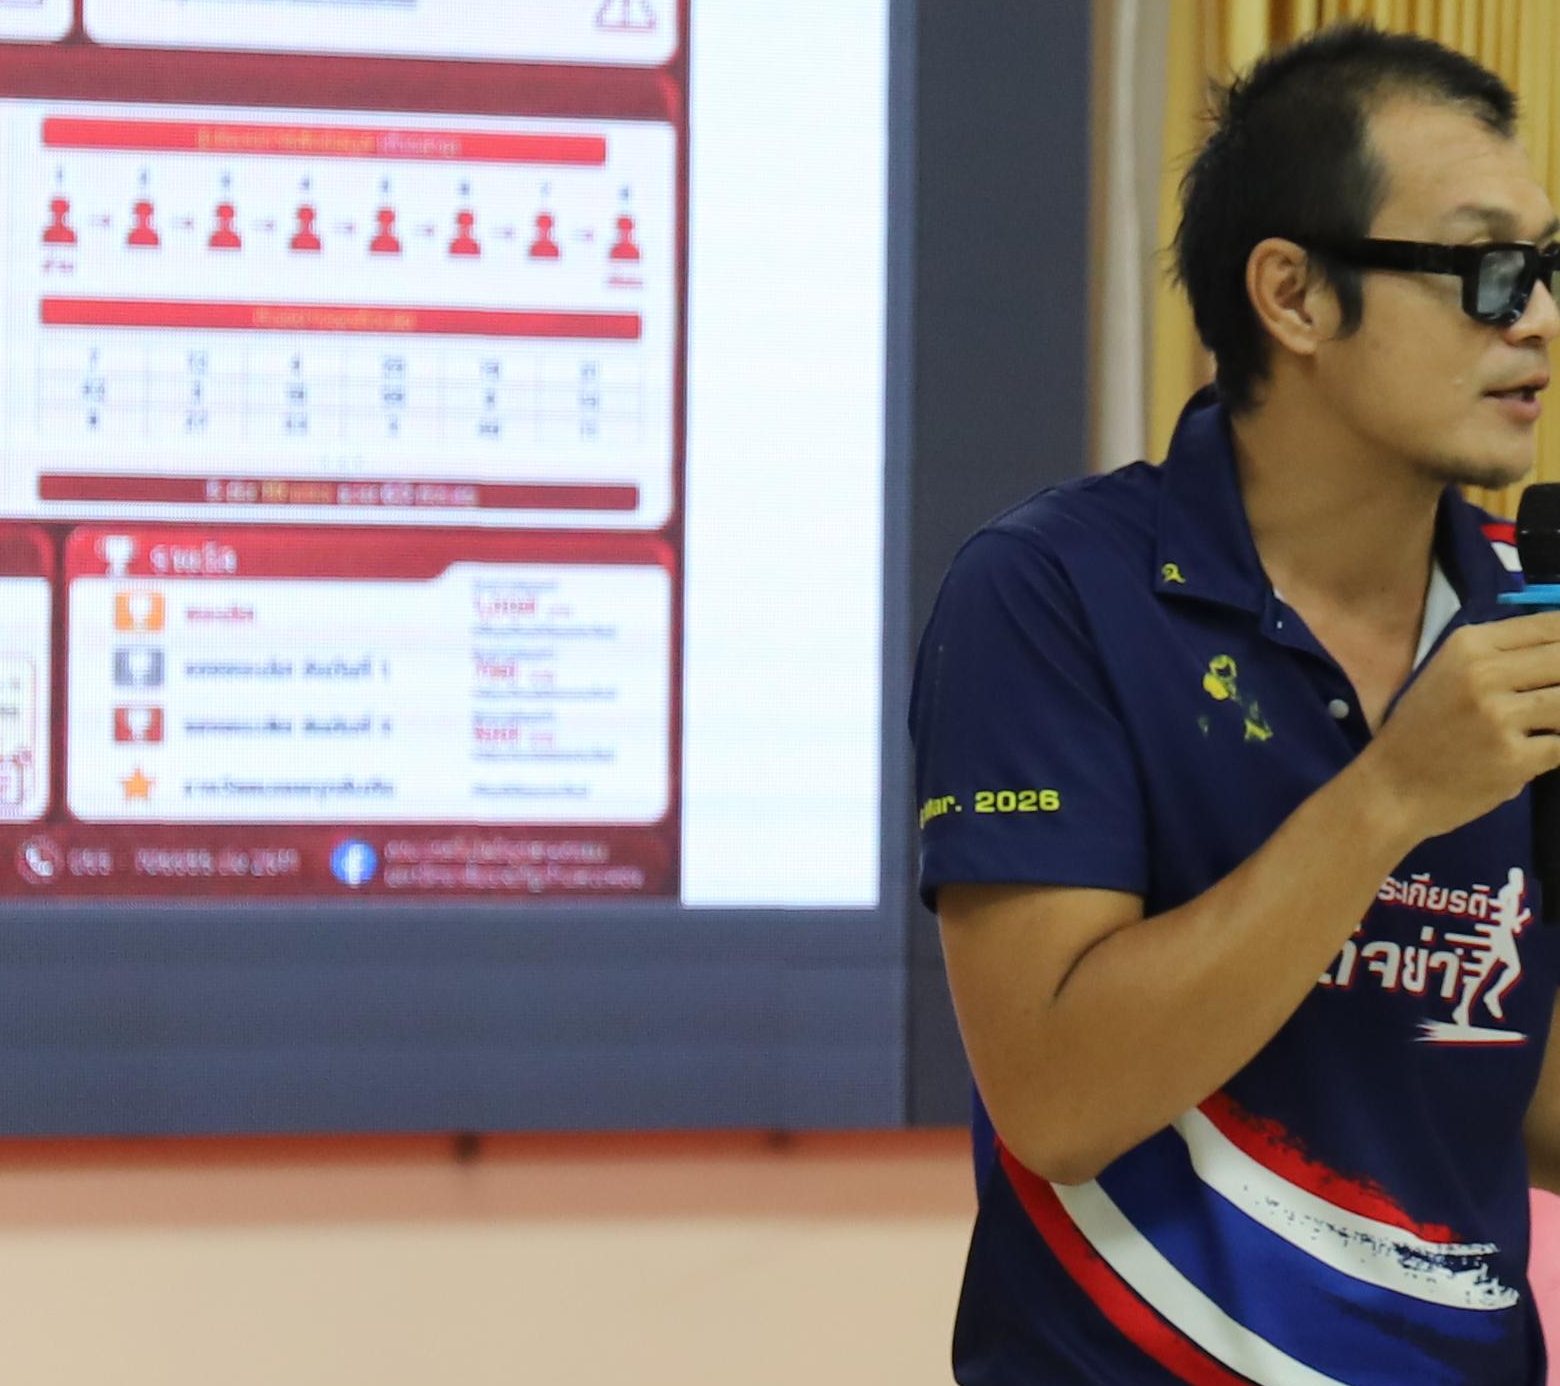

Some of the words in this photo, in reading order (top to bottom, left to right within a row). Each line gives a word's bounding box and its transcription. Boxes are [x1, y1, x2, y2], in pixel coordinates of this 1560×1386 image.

[974, 789, 1060, 813] 2026
[1376, 872, 1490, 919] ระเกียรติ
